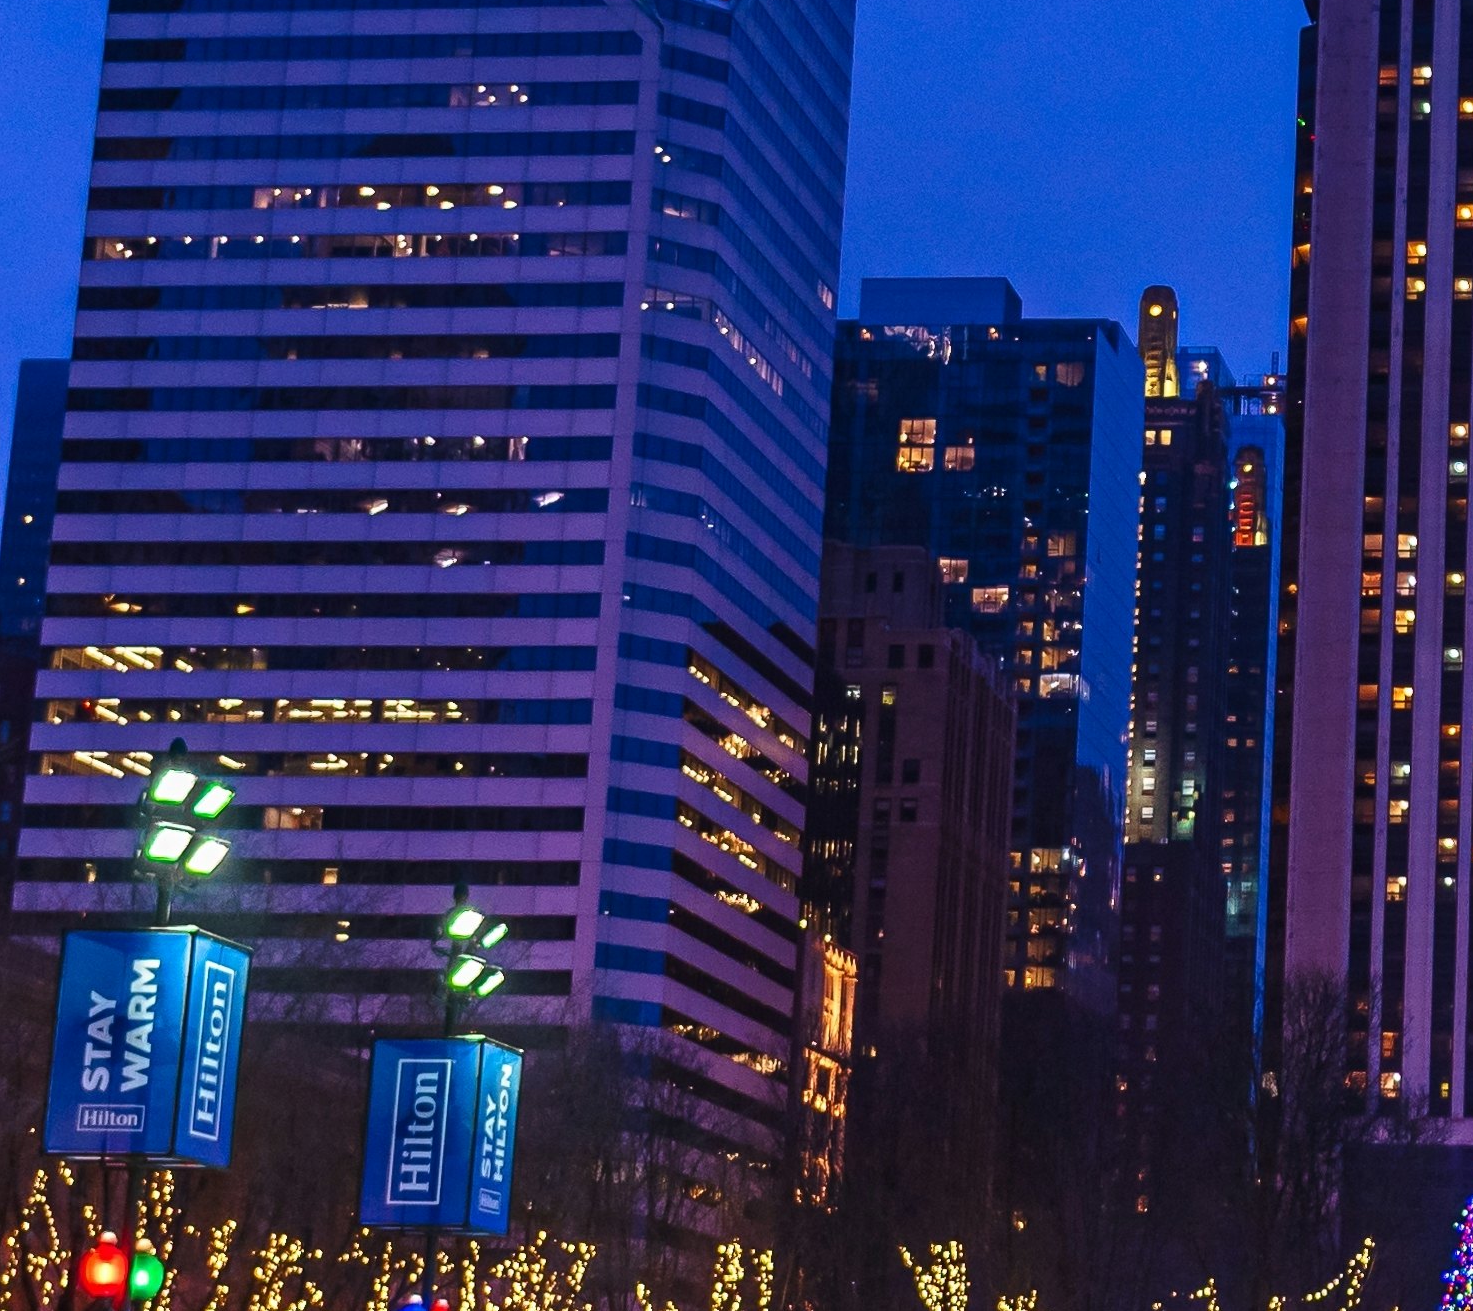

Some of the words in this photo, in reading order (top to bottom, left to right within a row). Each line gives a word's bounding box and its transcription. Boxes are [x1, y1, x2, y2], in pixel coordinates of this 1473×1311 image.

[82, 990, 117, 1093] STAY
[120, 958, 161, 1092] WARM
[197, 981, 227, 1125] Hilton
[83, 1109, 138, 1126] Hilton
[399, 1071, 439, 1192] Hilton
[481, 1094, 497, 1179] STAY
[493, 1063, 513, 1182] HILTON
